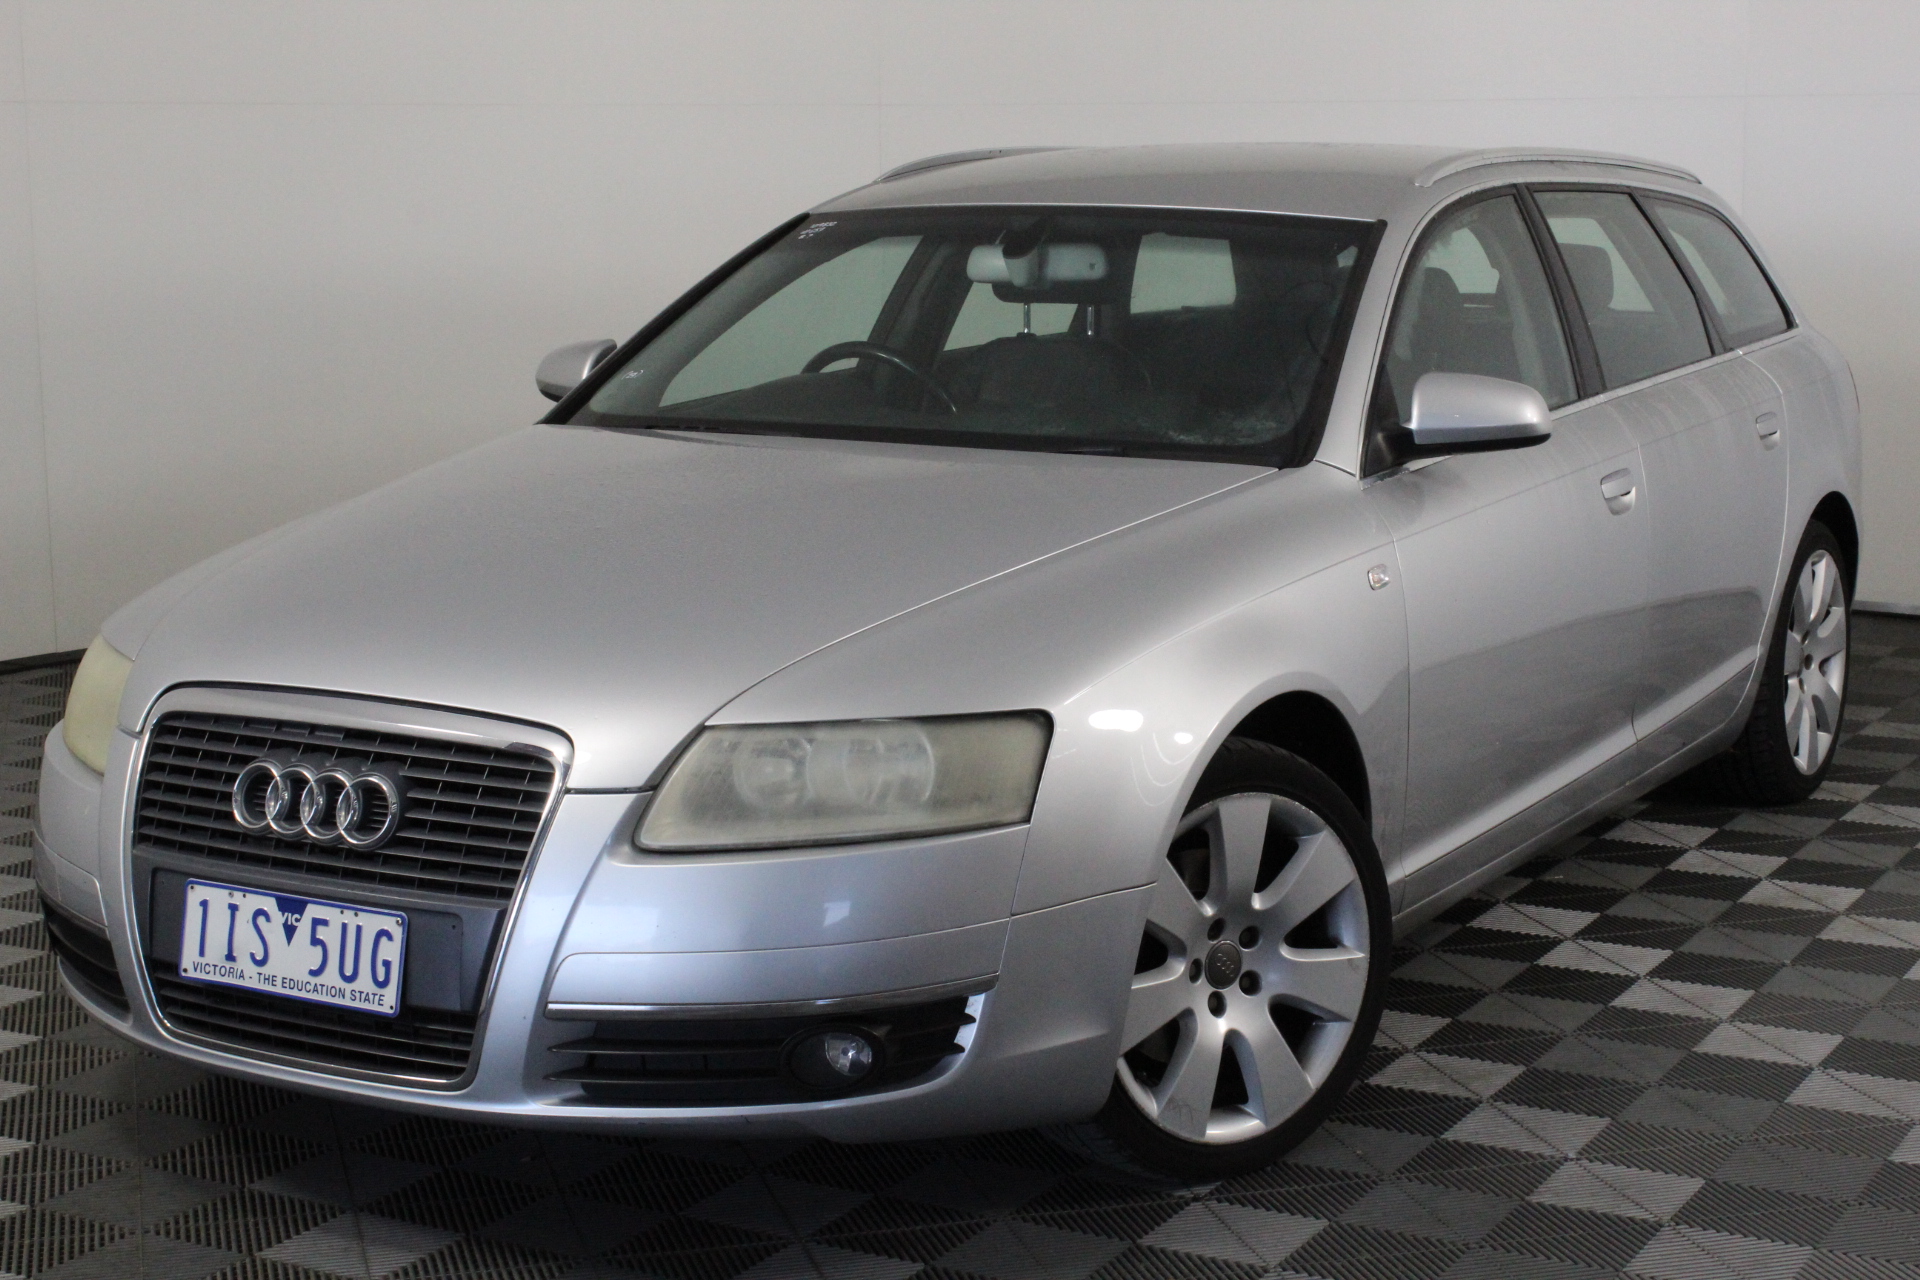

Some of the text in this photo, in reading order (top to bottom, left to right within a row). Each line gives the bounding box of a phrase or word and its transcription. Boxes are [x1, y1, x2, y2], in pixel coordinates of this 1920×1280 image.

[279, 911, 301, 927] VIC
[308, 916, 394, 989] 5UG
[192, 960, 245, 981] VICTORIA
[256, 972, 277, 988] THE
[281, 977, 346, 1000] EDUCATION
[349, 989, 385, 1007] STATE
